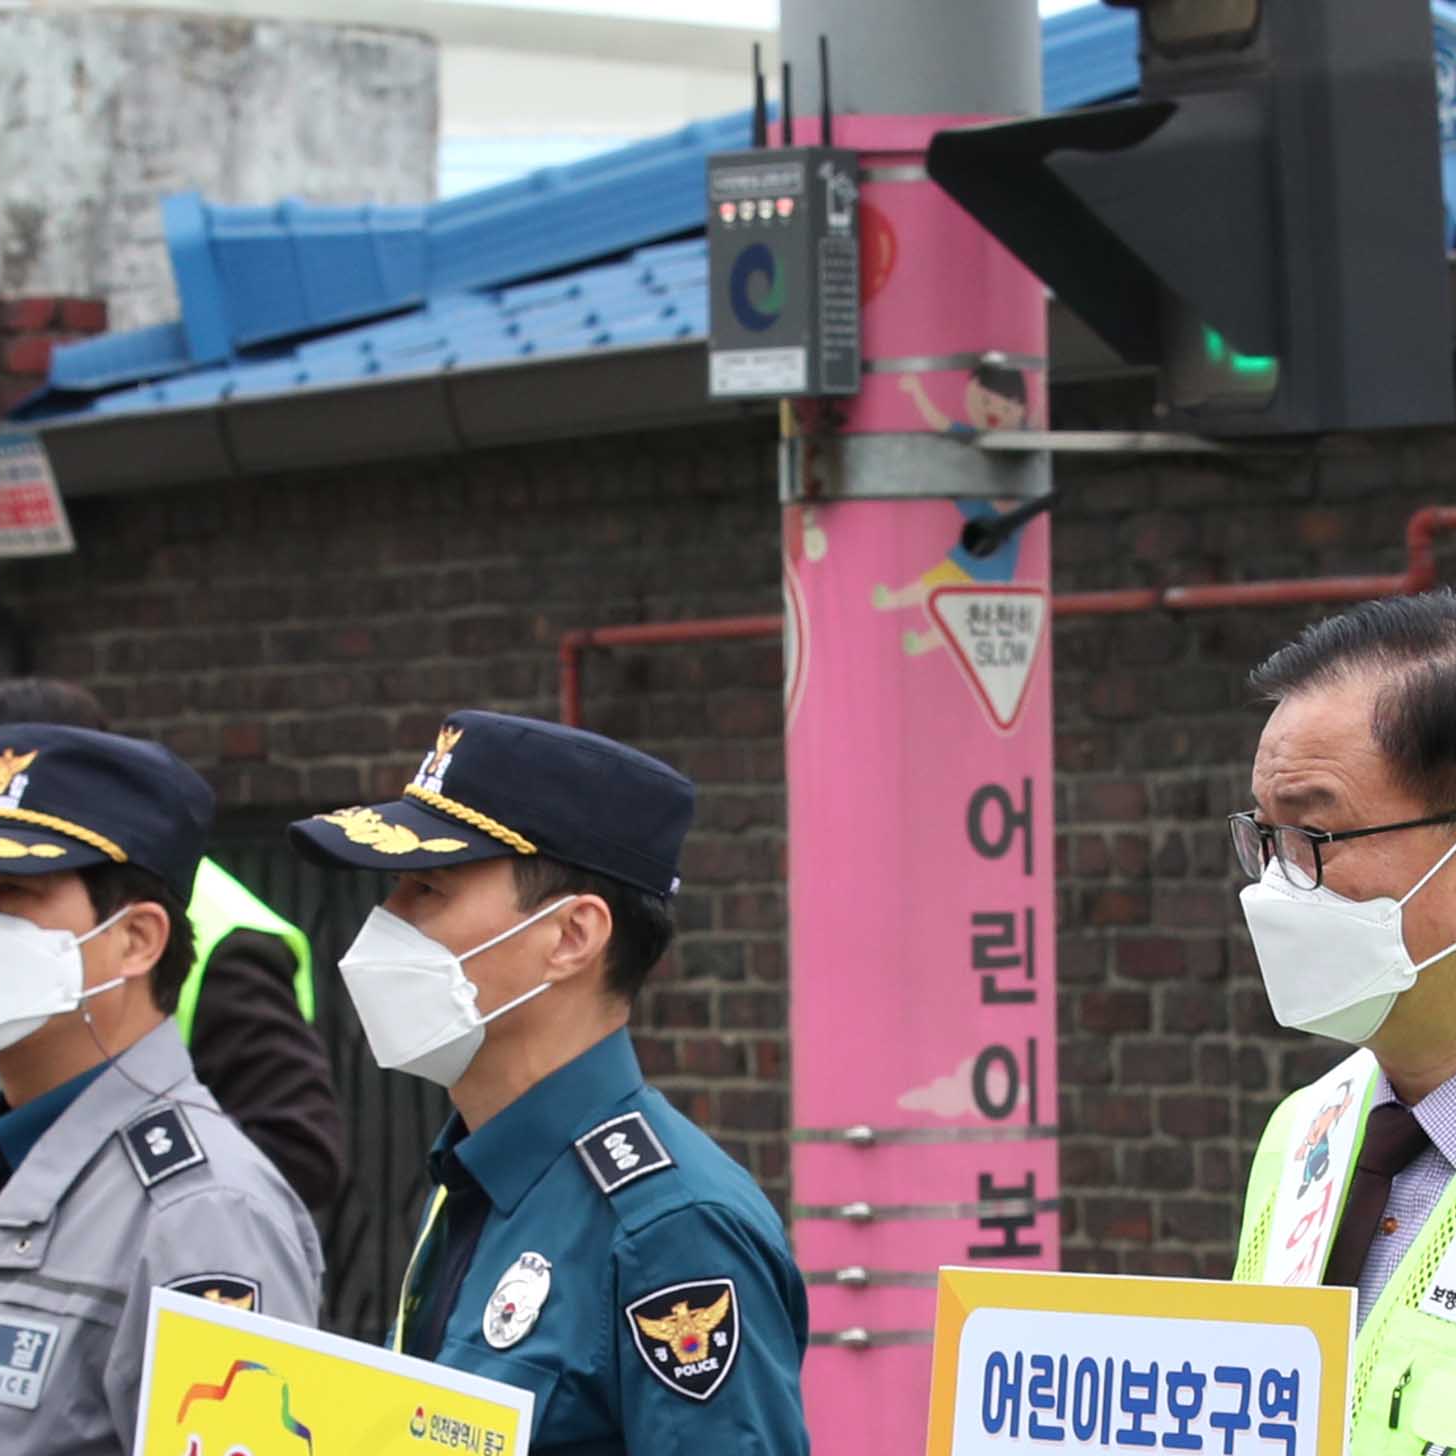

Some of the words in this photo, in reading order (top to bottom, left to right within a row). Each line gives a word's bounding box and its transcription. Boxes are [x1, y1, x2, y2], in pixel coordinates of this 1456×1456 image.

[976, 639, 1027, 667] SLOW
[673, 1357, 720, 1379] POLICE
[430, 1413, 482, 1454] 인천광역시
